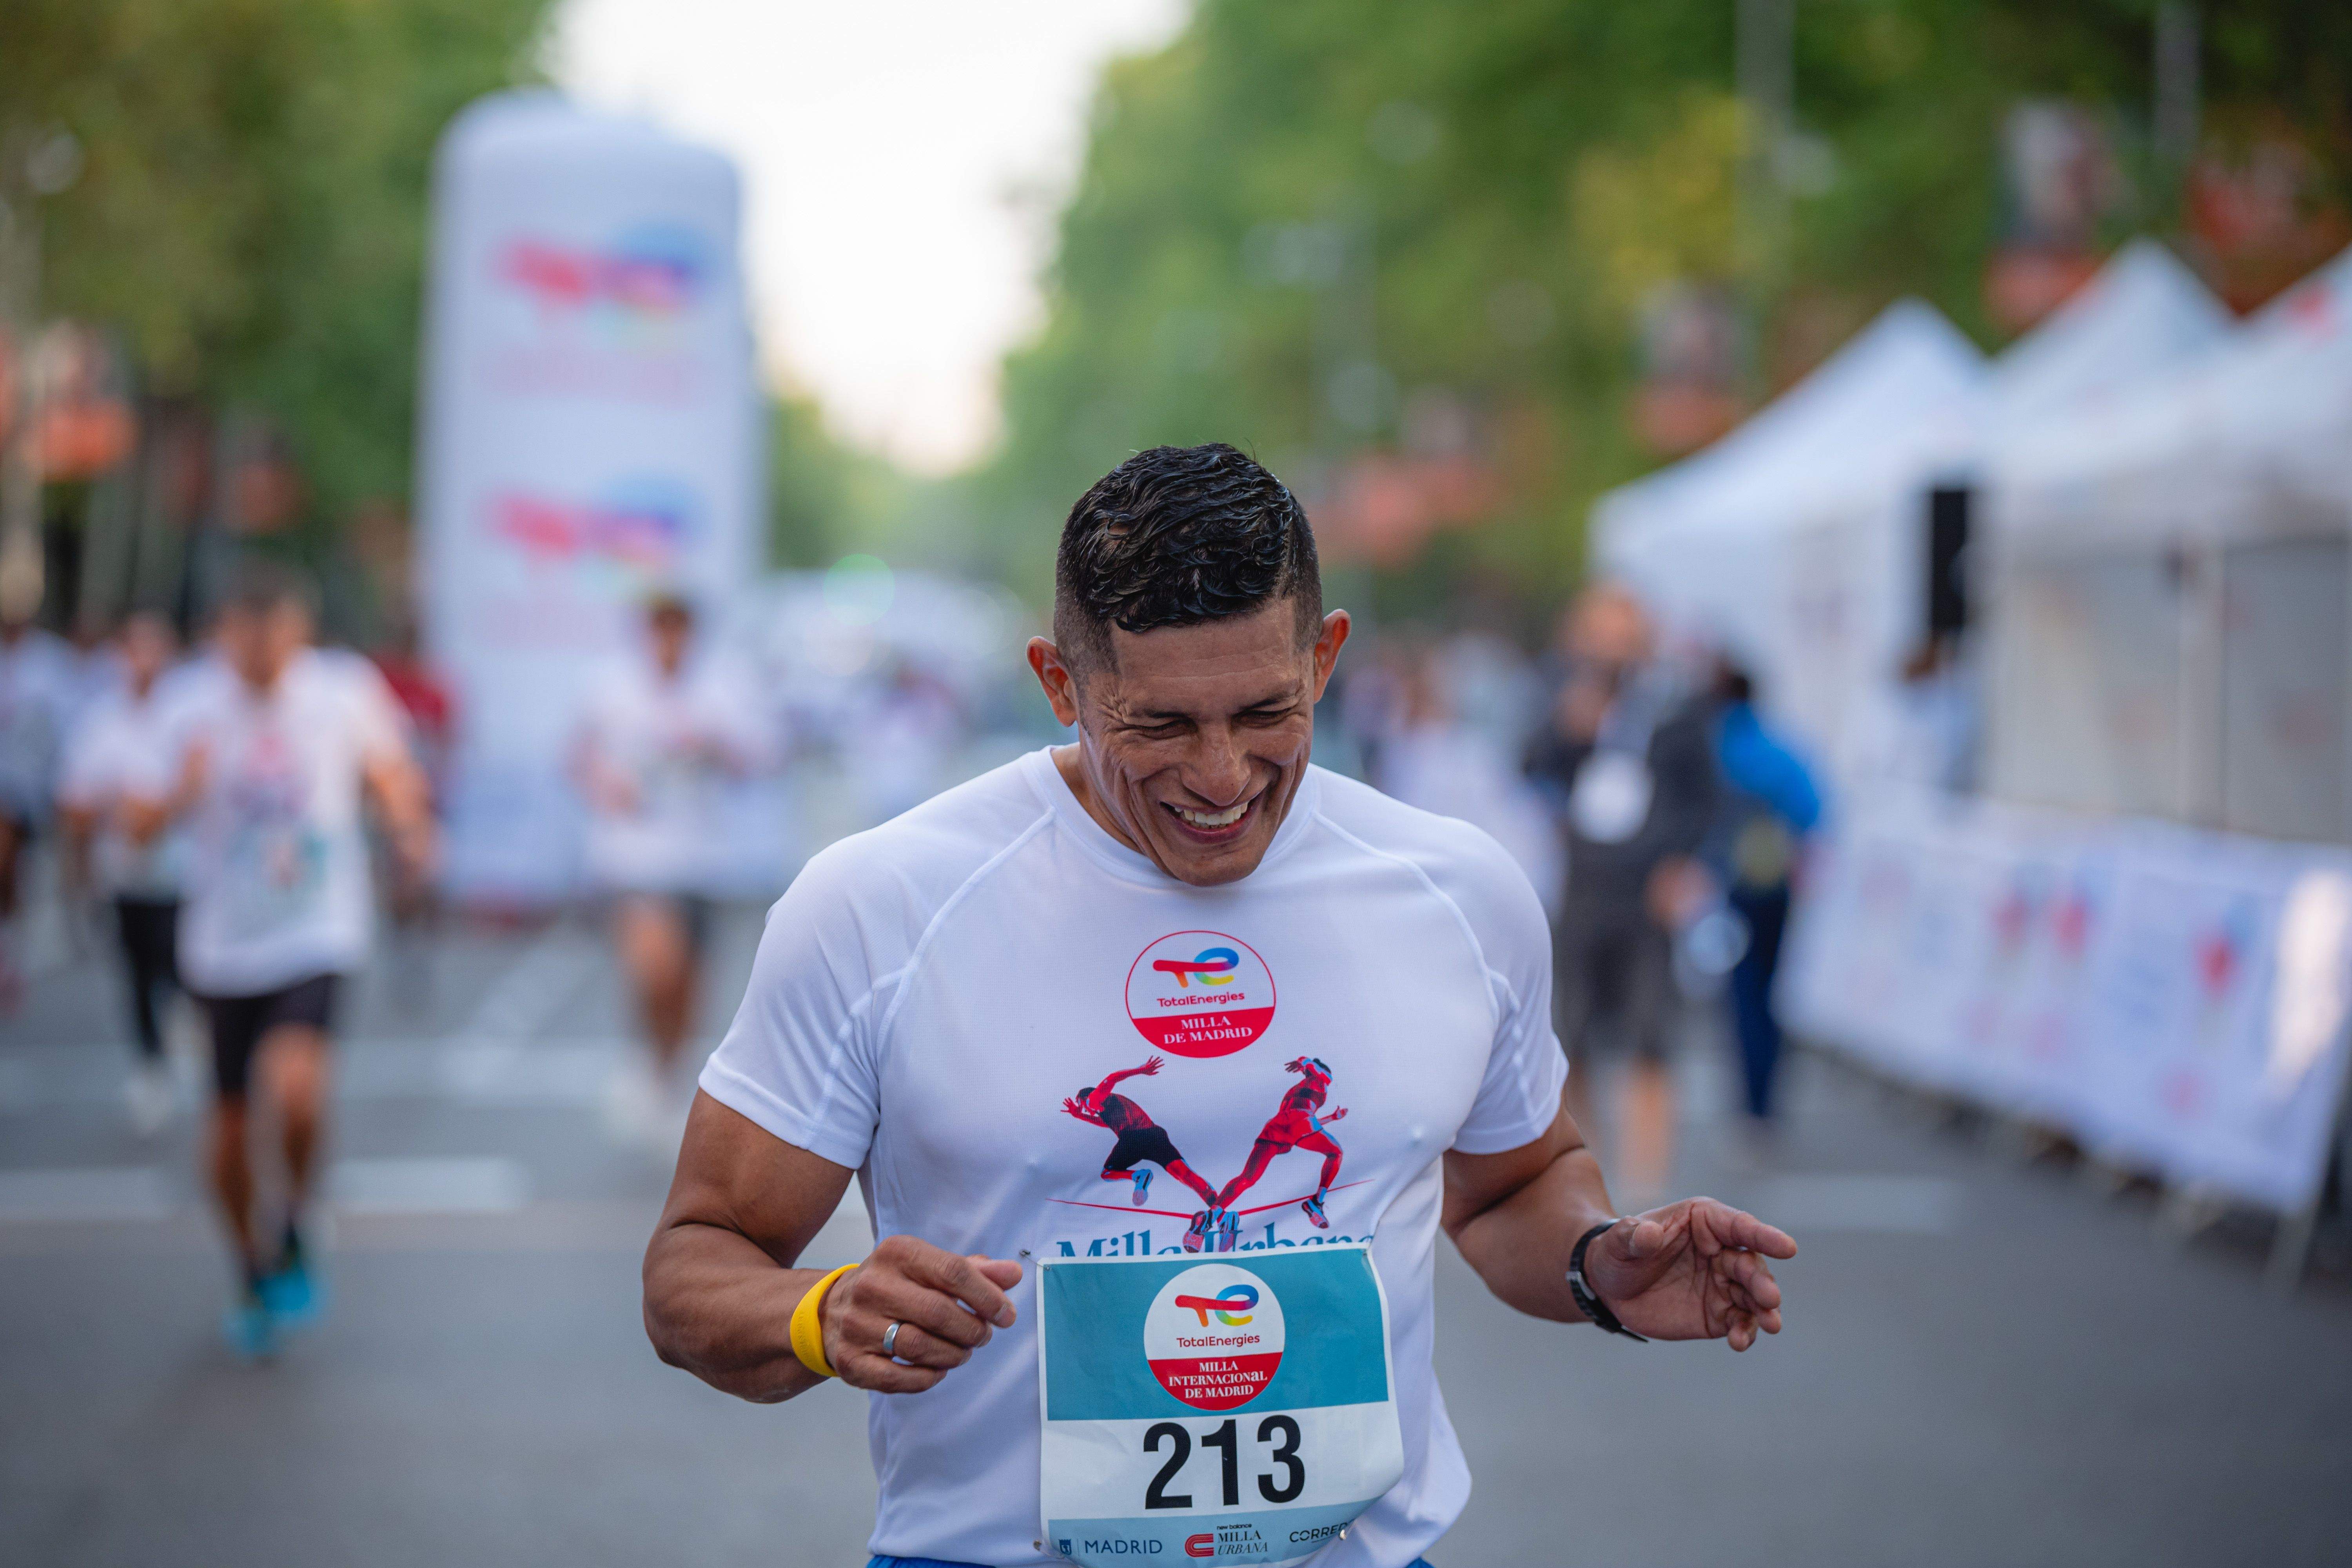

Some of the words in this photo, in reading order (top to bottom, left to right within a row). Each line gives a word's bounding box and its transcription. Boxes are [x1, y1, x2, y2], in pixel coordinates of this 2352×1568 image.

[1157, 991, 1245, 1007] TotalEnergies
[1181, 1015, 1231, 1029] MILLA
[1164, 1033, 1186, 1044] DE
[1189, 1027, 1252, 1042] MADRID
[1176, 1334, 1260, 1348] TotalEnergies
[1200, 1361, 1238, 1372] MILLA
[1185, 1388, 1203, 1399] DE
[1206, 1385, 1254, 1397] MADRID
[1143, 1414, 1305, 1509] 213
[1218, 1530, 1261, 1543] MILLA
[1085, 1540, 1162, 1553] MADRID
[1218, 1542, 1268, 1555] URBANA
